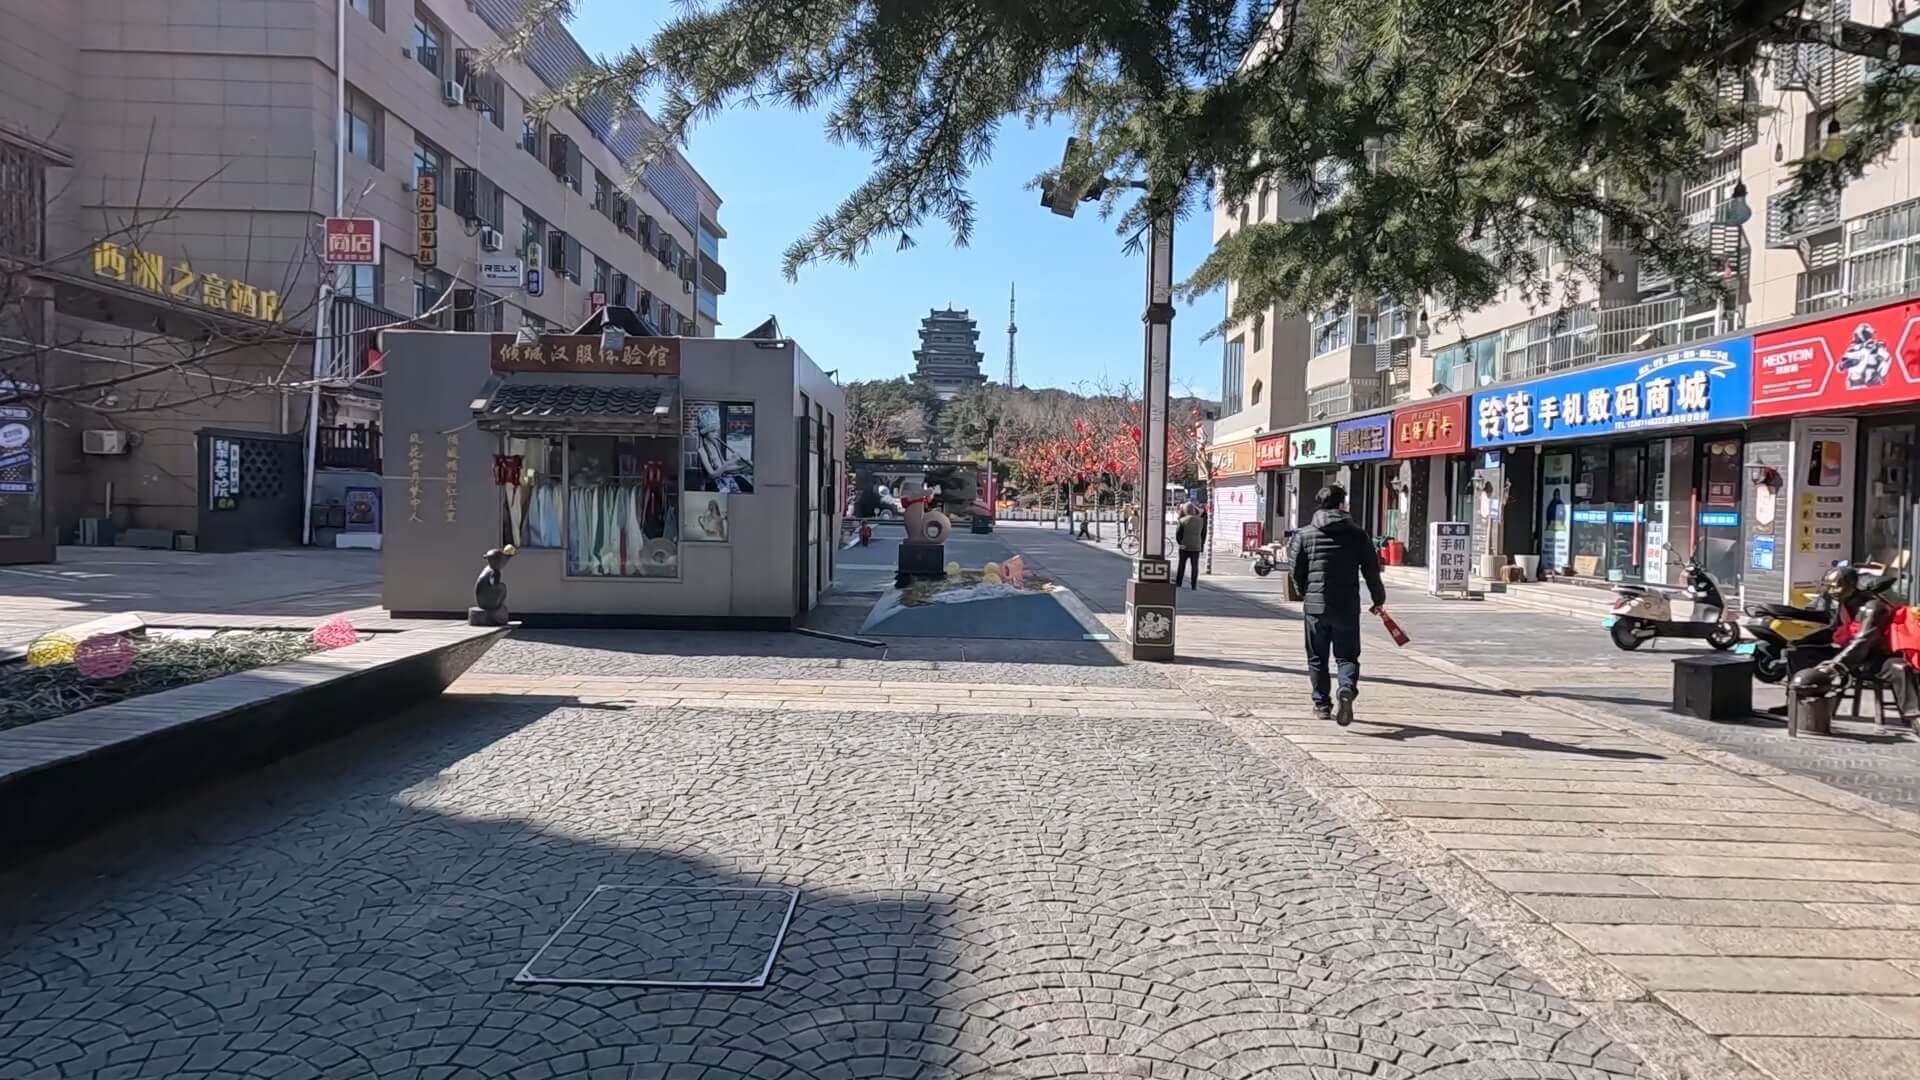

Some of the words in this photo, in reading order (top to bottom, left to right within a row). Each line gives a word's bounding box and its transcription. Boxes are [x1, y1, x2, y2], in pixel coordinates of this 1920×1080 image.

[419, 178, 433, 263] 老北京布鞋
[484, 264, 518, 273] RELX
[1478, 369, 1710, 439] 铃铛手机数码商城
[1440, 538, 1465, 551] 手机
[1440, 552, 1465, 566] 配件
[1440, 567, 1465, 581] 批发
